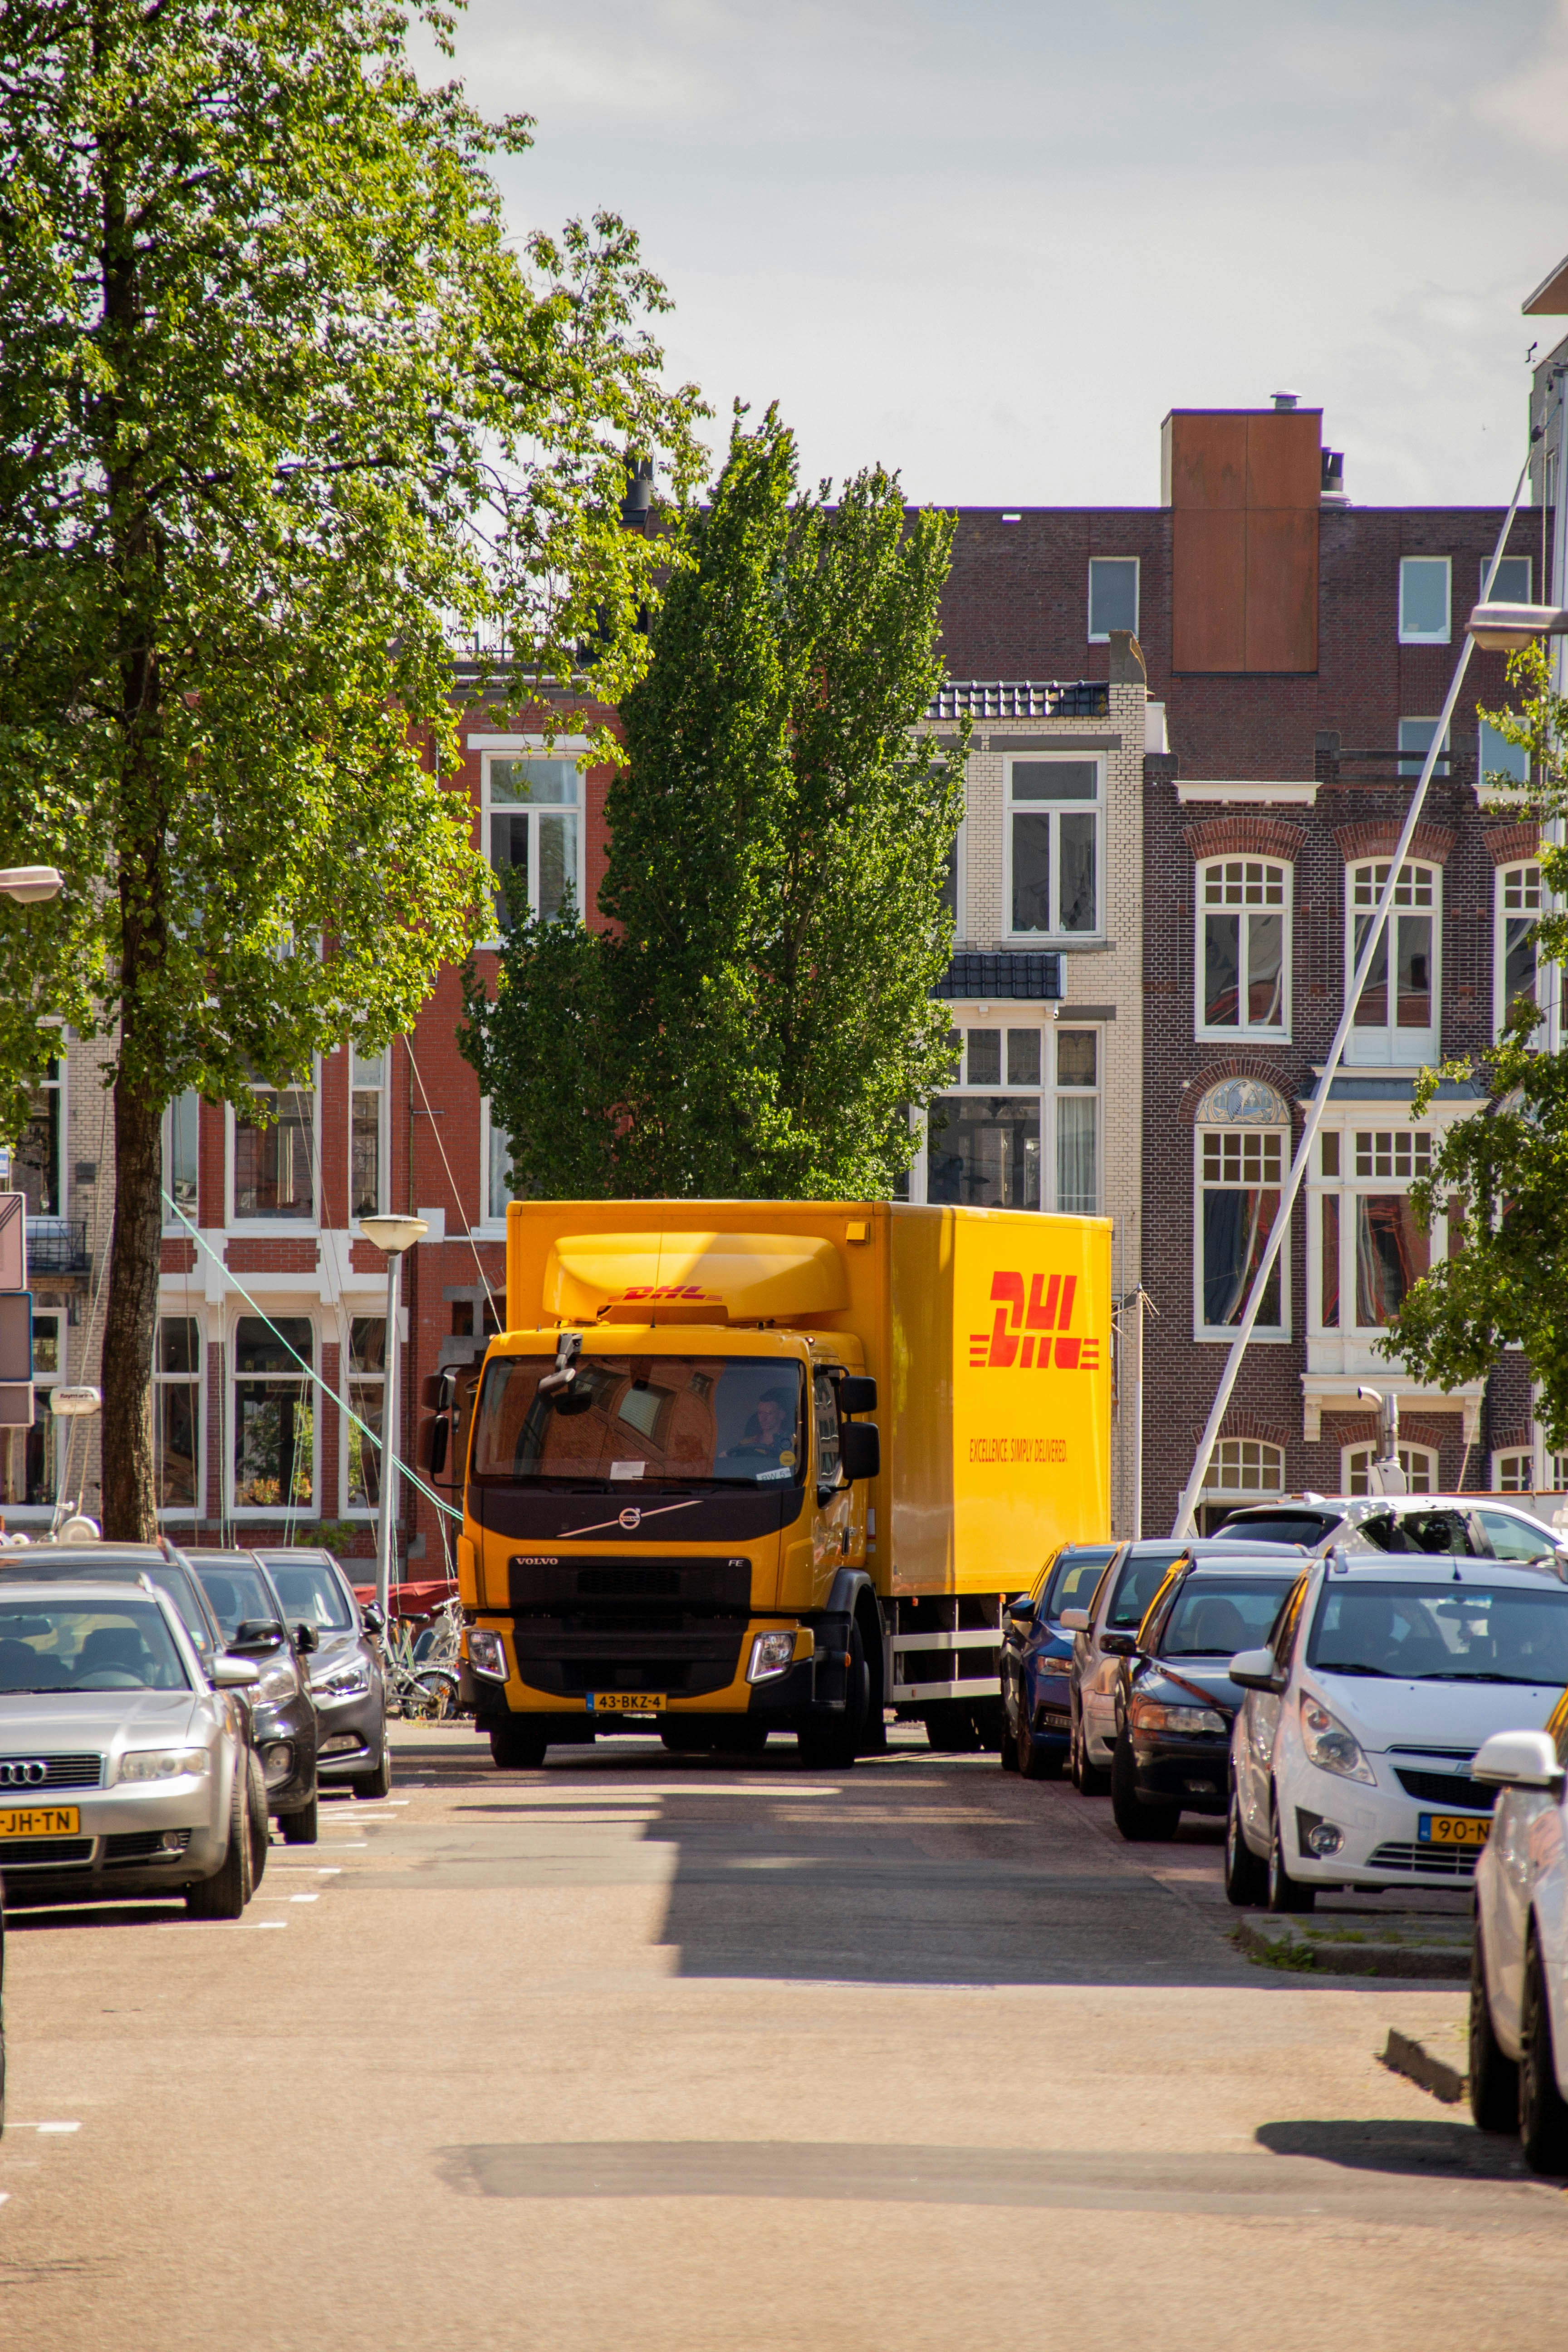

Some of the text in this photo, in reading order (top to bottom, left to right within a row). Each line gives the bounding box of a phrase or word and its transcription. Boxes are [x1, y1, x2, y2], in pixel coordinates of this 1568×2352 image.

[622, 1286, 703, 1300] DHL
[988, 1271, 1082, 1369] DHL
[970, 1438, 1068, 1463] EXCELLENCE. SIMPLY DELIVERED.
[599, 1695, 661, 1708] 43-BKZ-4
